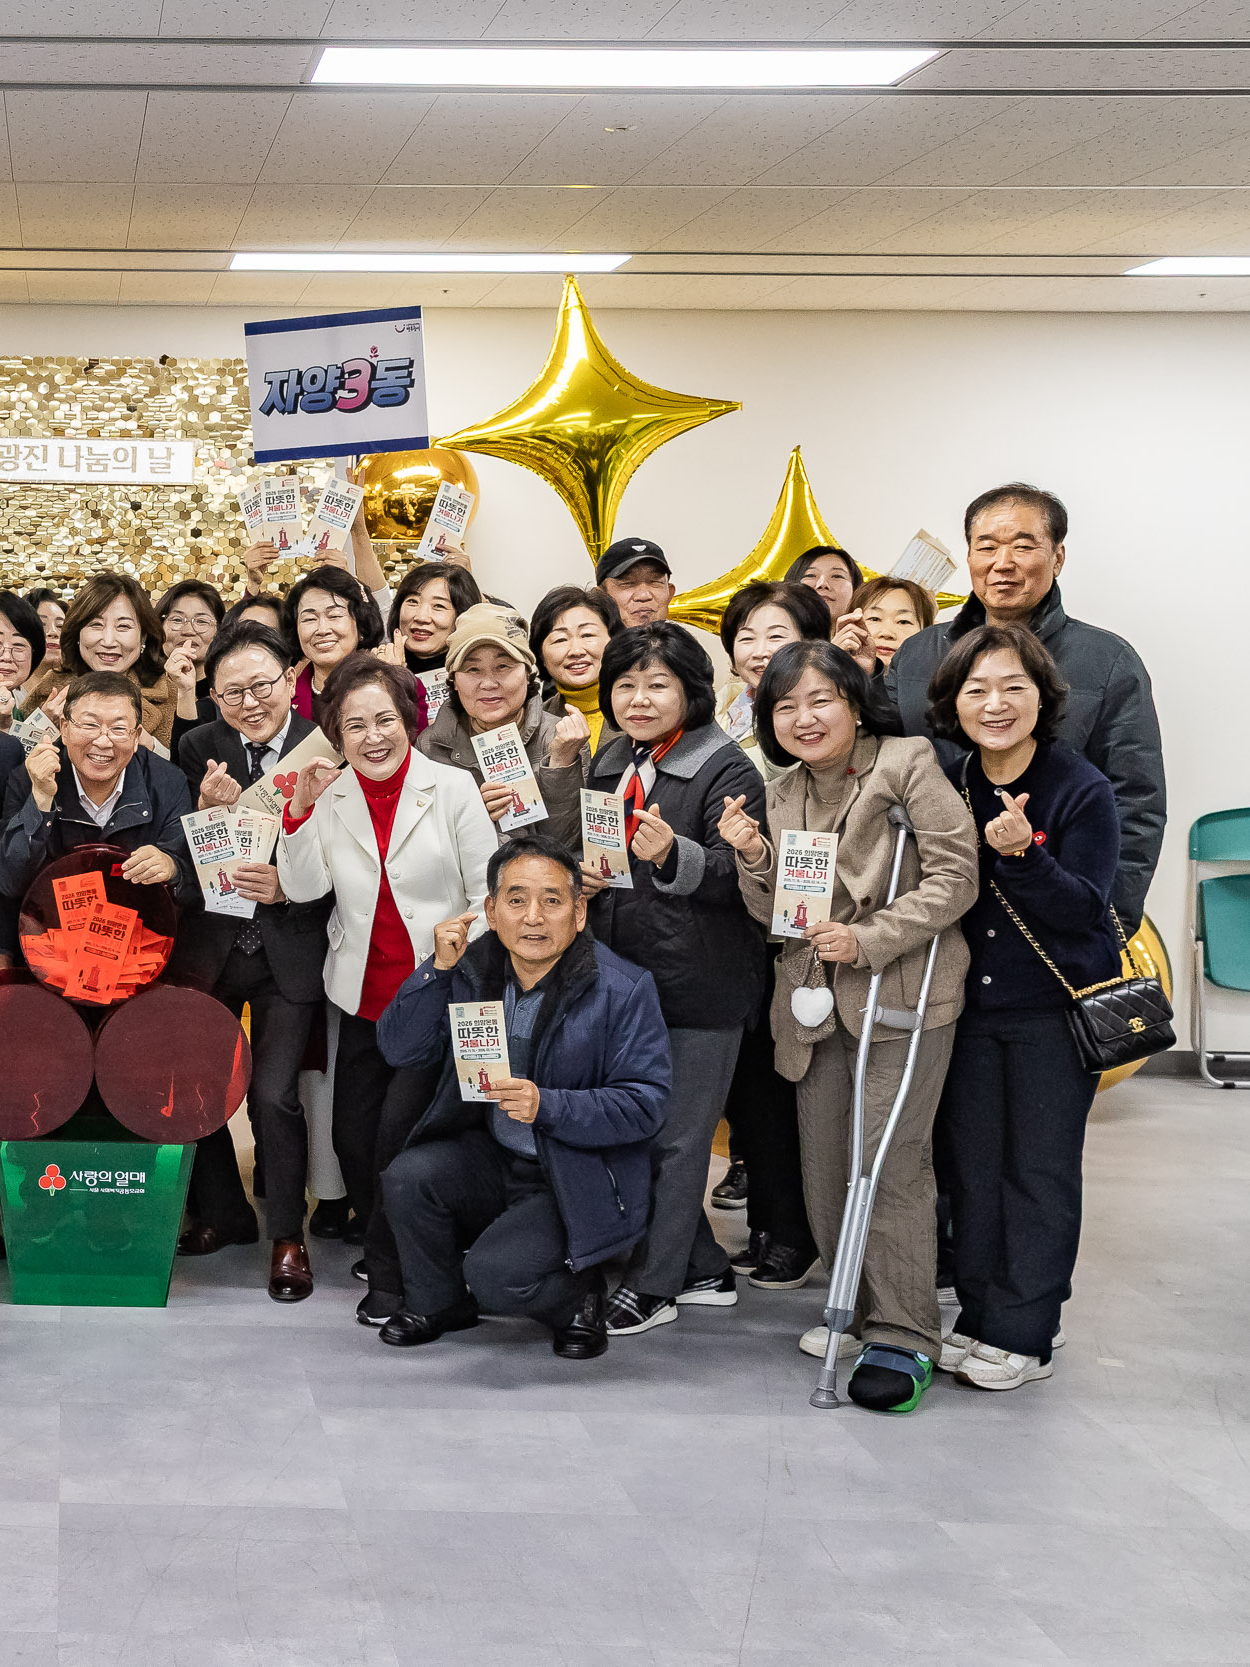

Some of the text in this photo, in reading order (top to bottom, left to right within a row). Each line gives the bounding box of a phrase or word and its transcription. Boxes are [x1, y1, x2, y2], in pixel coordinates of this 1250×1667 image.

[259, 358, 415, 417] 자양3동
[58, 445, 138, 473] 나눔의
[148, 446, 175, 474] 날
[244, 498, 262, 515] 따뜻
[266, 494, 295, 505] 따뜻한
[267, 503, 296, 512] 겨울나기
[324, 494, 354, 513] 따뜻한
[439, 498, 466, 517] 따뜻한
[321, 503, 351, 520] 겨울나기
[437, 507, 463, 524] 겨울나기
[481, 748, 495, 756] 2026
[483, 747, 520, 766] 따뜻한
[487, 757, 523, 775] 겨울나기
[586, 813, 619, 827] 따뜻한
[192, 827, 229, 846] 따뜻한
[587, 824, 619, 836] 겨울나기
[196, 839, 231, 854] 겨울나기
[785, 855, 829, 870] 따뜻한
[784, 868, 827, 880] 겨울나기
[92, 916, 106, 924] 2026
[89, 921, 126, 941] 따뜻한
[458, 1026, 499, 1039] 따뜻한
[459, 1038, 500, 1048] 겨울나기
[69, 1170, 146, 1187] 사랑의 열매
